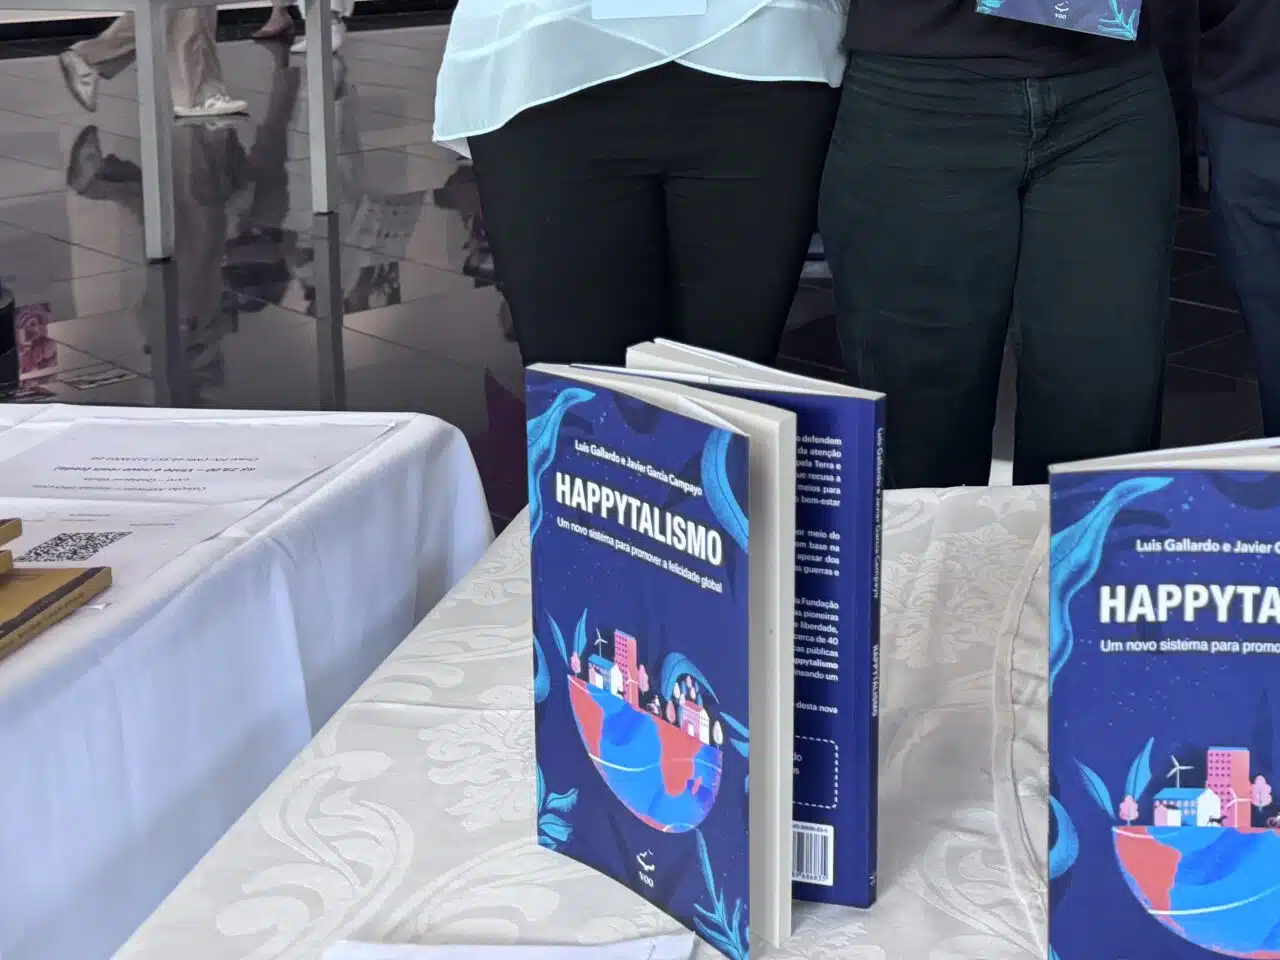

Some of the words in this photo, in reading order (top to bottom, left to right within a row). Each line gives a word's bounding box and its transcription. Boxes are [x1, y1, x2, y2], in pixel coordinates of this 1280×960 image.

[575, 440, 589, 453] Luis
[590, 444, 620, 463] Gallardo
[620, 457, 626, 465] e
[626, 457, 646, 473] Javier
[668, 474, 702, 496] Campayo
[556, 472, 722, 565] HAPPYTALISMO
[1136, 539, 1162, 552] Luis
[1164, 538, 1220, 552] Gallardo
[1221, 542, 1231, 552] e
[1233, 540, 1272, 553] Javier
[556, 516, 570, 529] Um
[570, 523, 587, 535] novo
[588, 529, 615, 546] sistema
[615, 539, 630, 552] para
[630, 546, 661, 566] promover
[662, 560, 668, 569] a
[668, 560, 701, 583] felicidade
[700, 576, 722, 593] global
[1100, 639, 1123, 652] Um
[1125, 640, 1157, 651] novo
[1159, 639, 1208, 651] sistema
[1210, 641, 1239, 653] para
